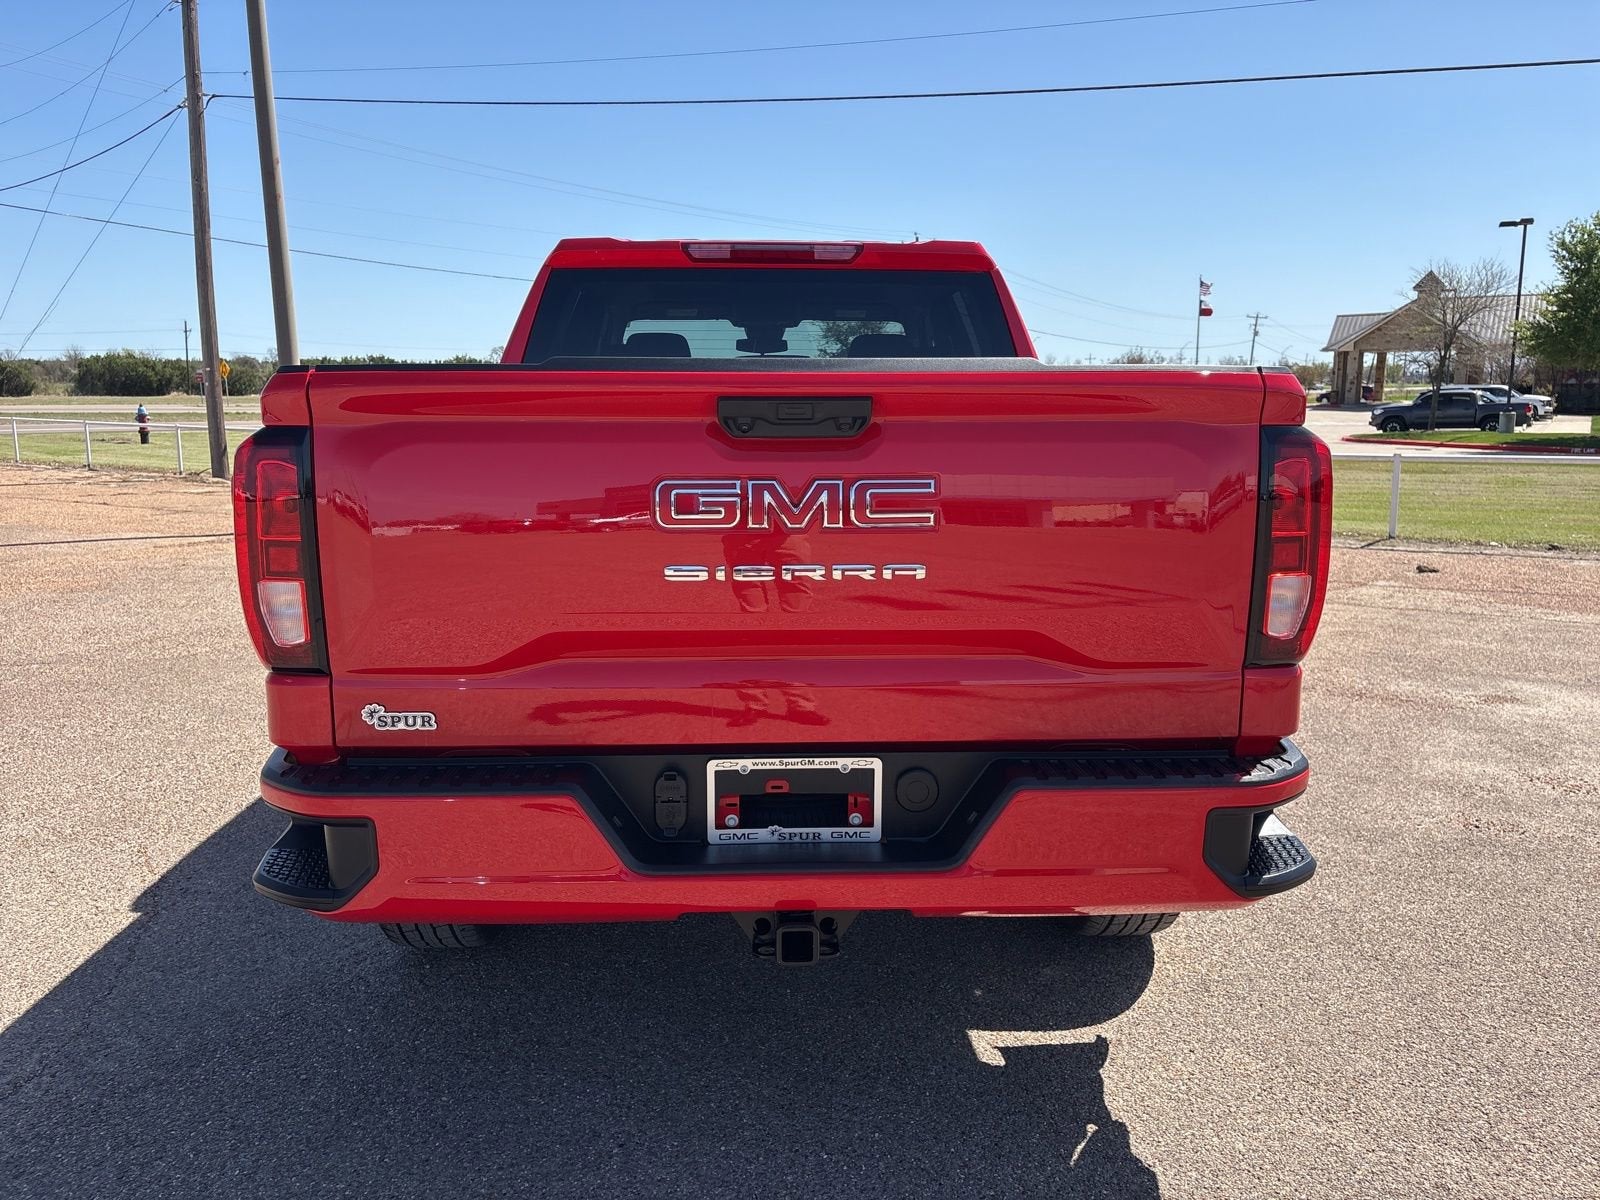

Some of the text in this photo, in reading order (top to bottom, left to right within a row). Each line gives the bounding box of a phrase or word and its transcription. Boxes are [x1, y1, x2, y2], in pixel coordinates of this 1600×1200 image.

[654, 479, 937, 529] GMC
[663, 564, 926, 582] SIERRA
[377, 714, 434, 728] SPUR
[751, 759, 839, 768] www.SpurGM.com
[718, 831, 871, 841] GMC SPUR GMC
